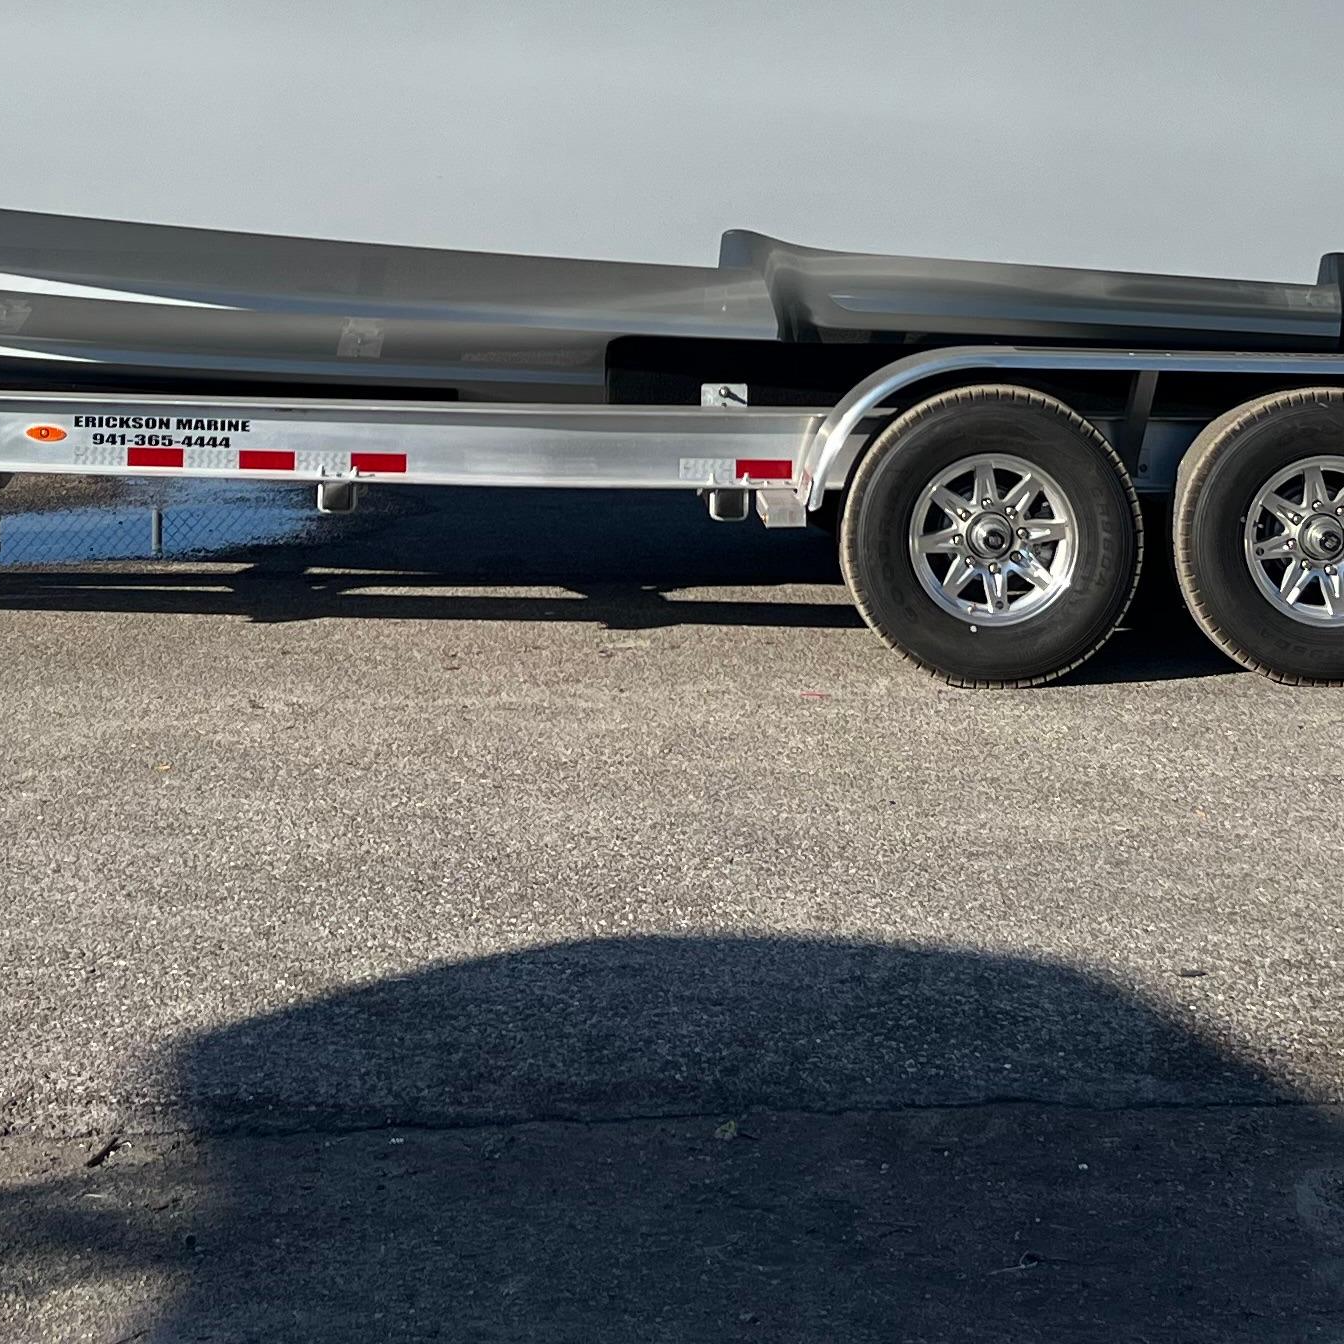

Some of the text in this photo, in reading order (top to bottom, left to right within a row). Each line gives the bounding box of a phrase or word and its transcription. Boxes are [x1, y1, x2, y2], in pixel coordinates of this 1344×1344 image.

[74, 416, 251, 432] ERICKSON MARINE
[92, 433, 231, 448] 941-365-4444
